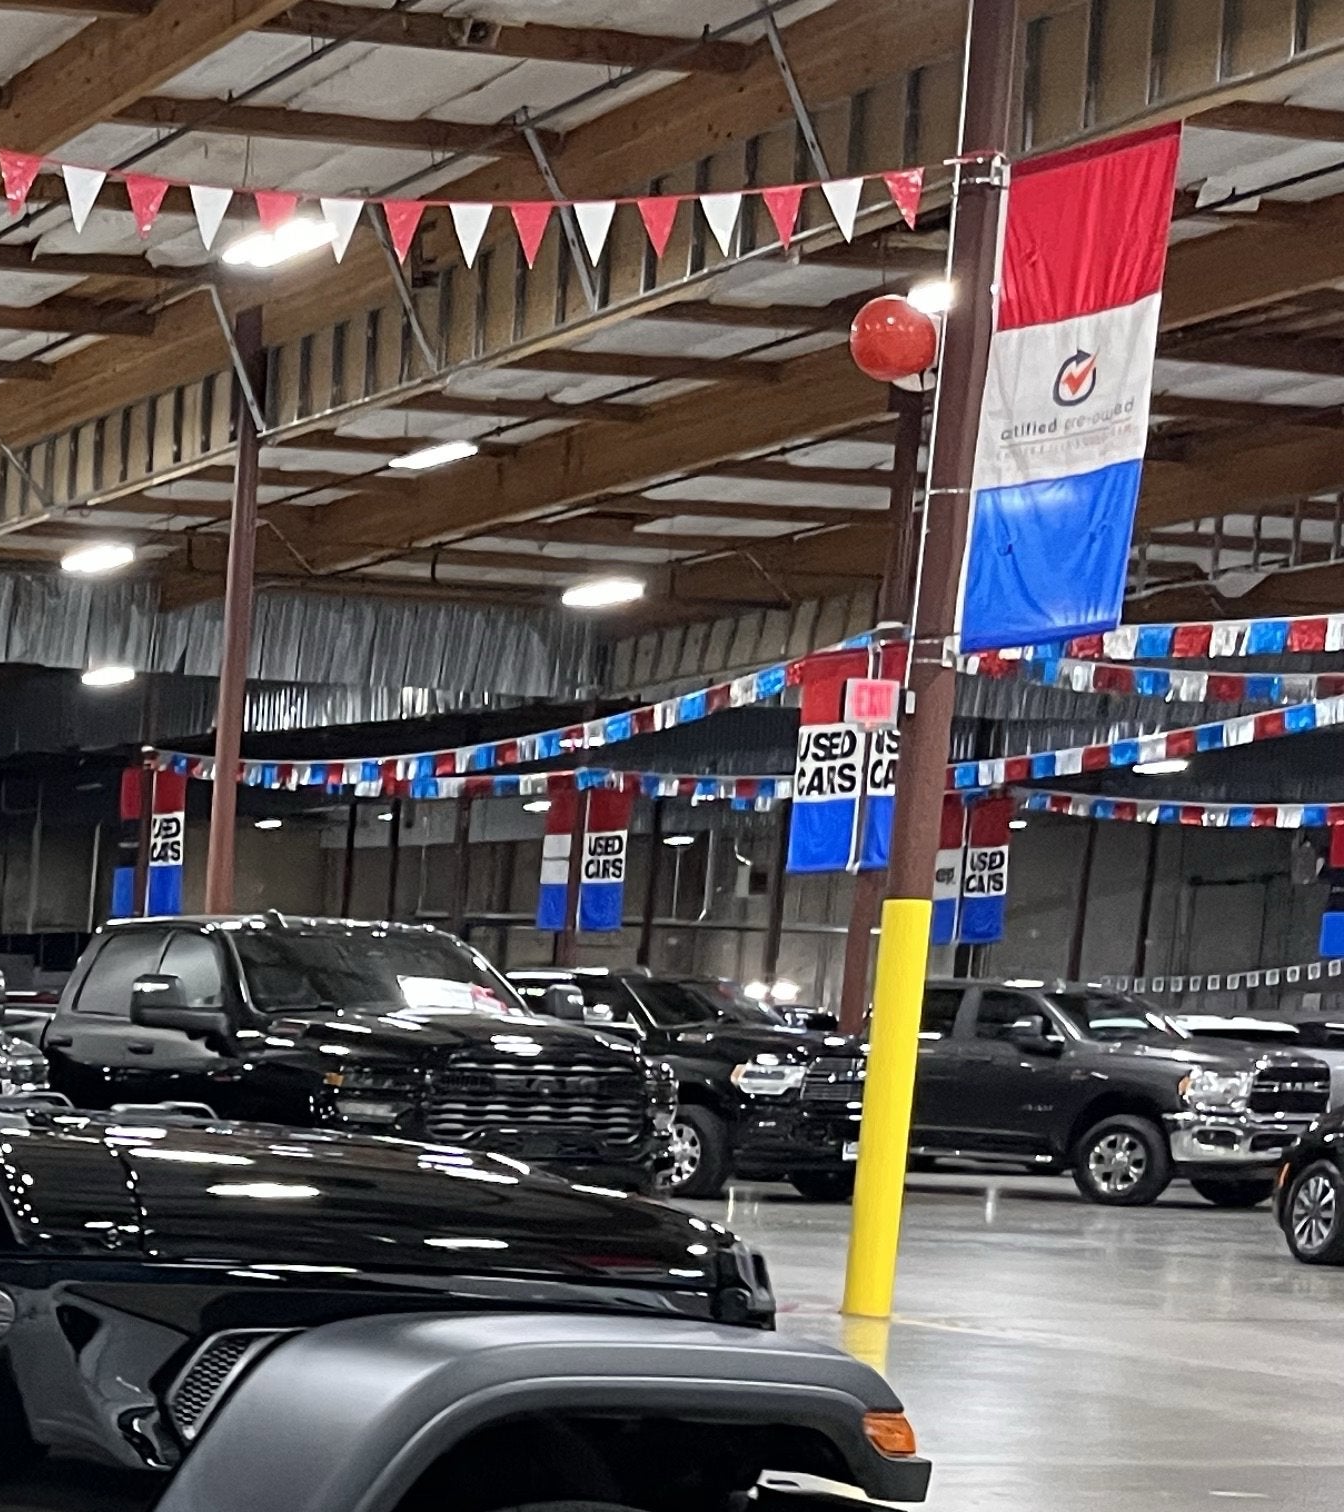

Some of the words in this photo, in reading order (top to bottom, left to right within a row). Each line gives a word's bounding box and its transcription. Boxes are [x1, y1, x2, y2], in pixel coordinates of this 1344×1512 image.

[799, 729, 857, 763] USED
[796, 762, 857, 796] CARS
[153, 817, 181, 840] UED
[588, 834, 624, 857] USED
